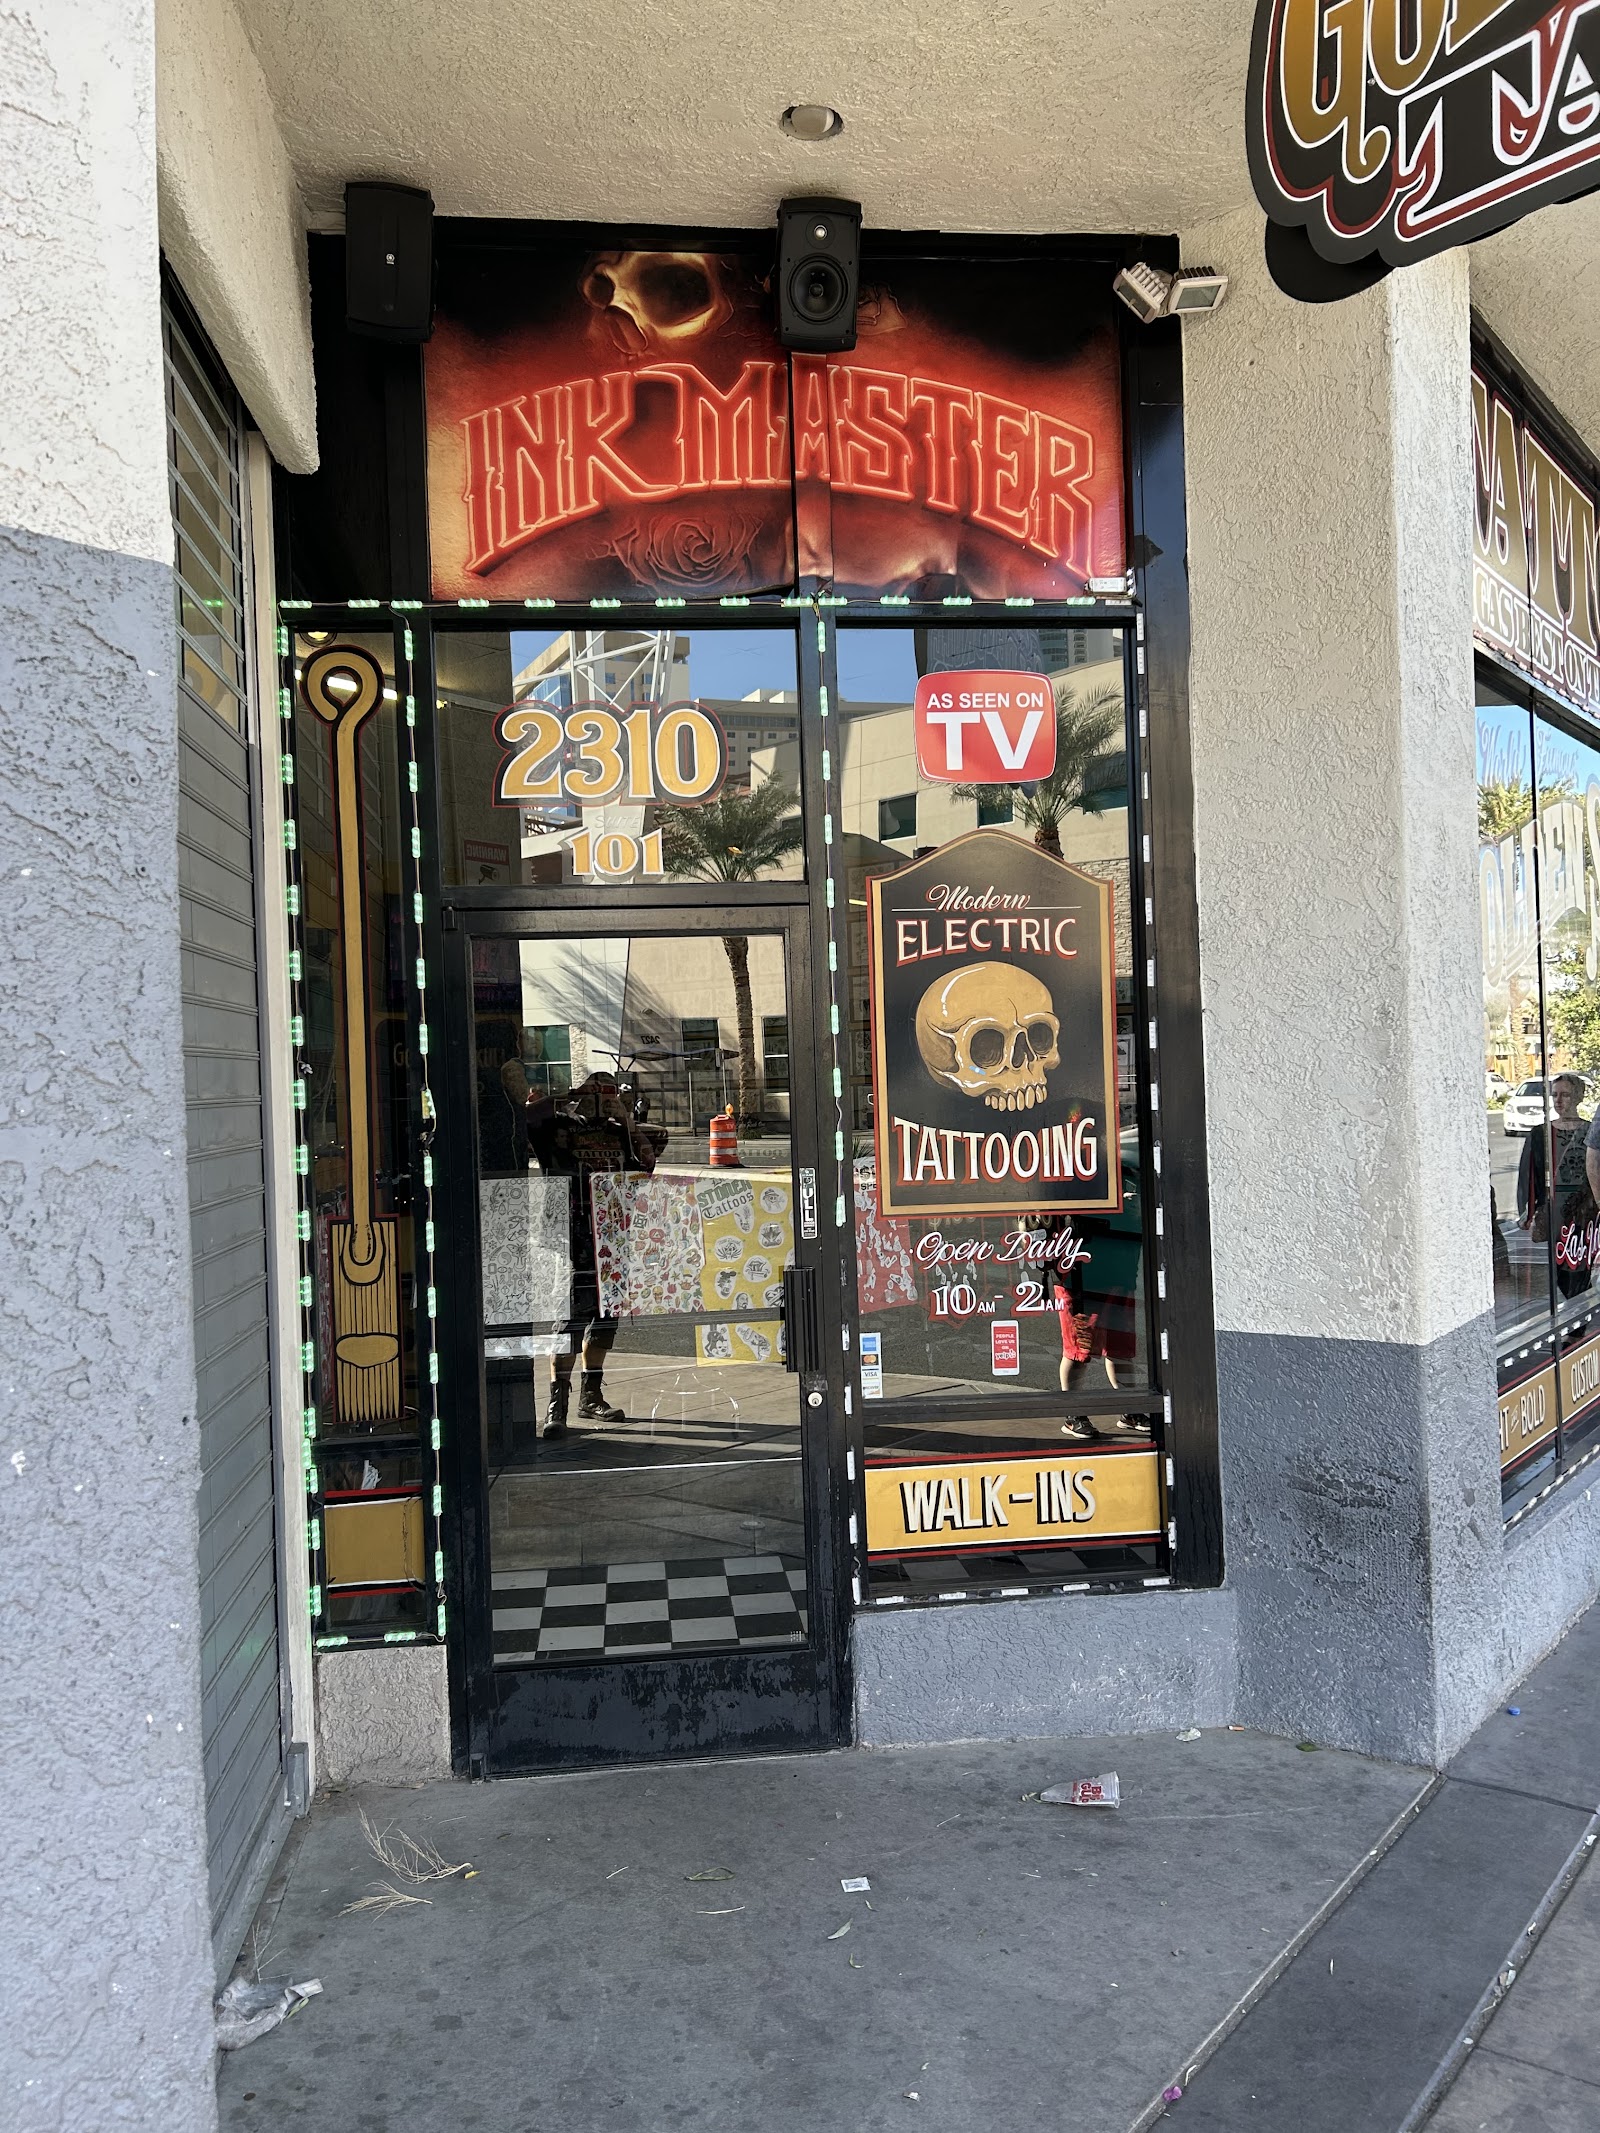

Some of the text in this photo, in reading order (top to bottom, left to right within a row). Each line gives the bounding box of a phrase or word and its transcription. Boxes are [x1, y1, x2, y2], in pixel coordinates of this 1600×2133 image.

[463, 358, 1096, 579] INK MASTER
[1472, 566, 1514, 649] GAS
[1513, 596, 1565, 684] BEST
[926, 692, 1044, 708] AS SEEN ON
[500, 708, 721, 799] 2310
[926, 710, 1045, 771] TV
[564, 827, 664, 876] 101
[927, 884, 1031, 912] Modern
[1479, 801, 1588, 988] OLDEN
[896, 917, 1078, 964] ELECTRIC
[577, 1150, 621, 1158] TATTOO
[893, 1117, 1098, 1182] TATTOOING
[702, 1192, 754, 1219] Tattoos
[915, 1226, 1092, 1271] Open Daily
[1520, 1384, 1546, 1437] BOLD
[900, 1468, 1096, 1534] WALK-INS
